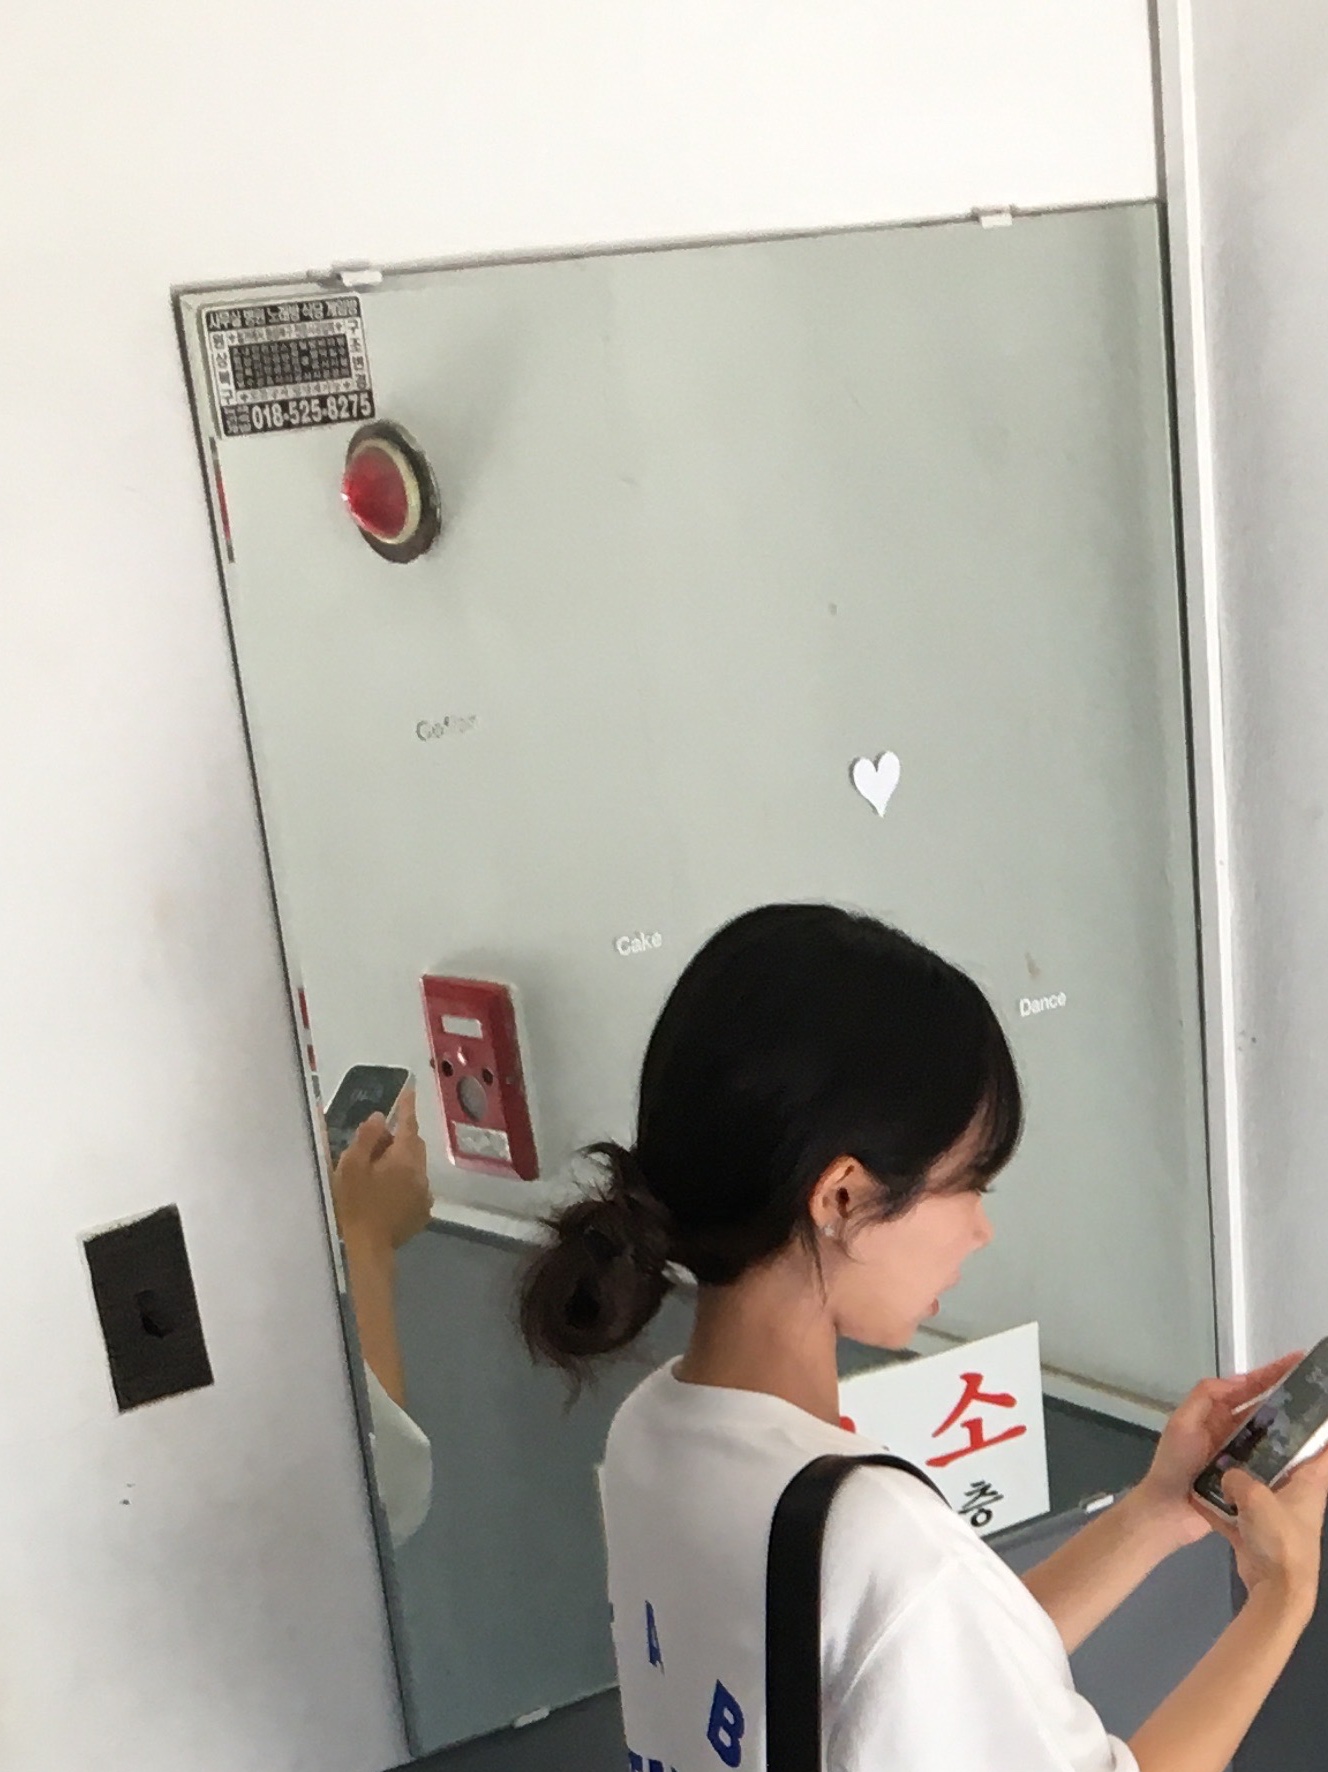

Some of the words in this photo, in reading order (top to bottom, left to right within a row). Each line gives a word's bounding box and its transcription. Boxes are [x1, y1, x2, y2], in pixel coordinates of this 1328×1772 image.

[615, 931, 663, 956] Cake
[1019, 991, 1067, 1017] Dance
[958, 1479, 1005, 1527] 층
[707, 1679, 745, 1768] B
